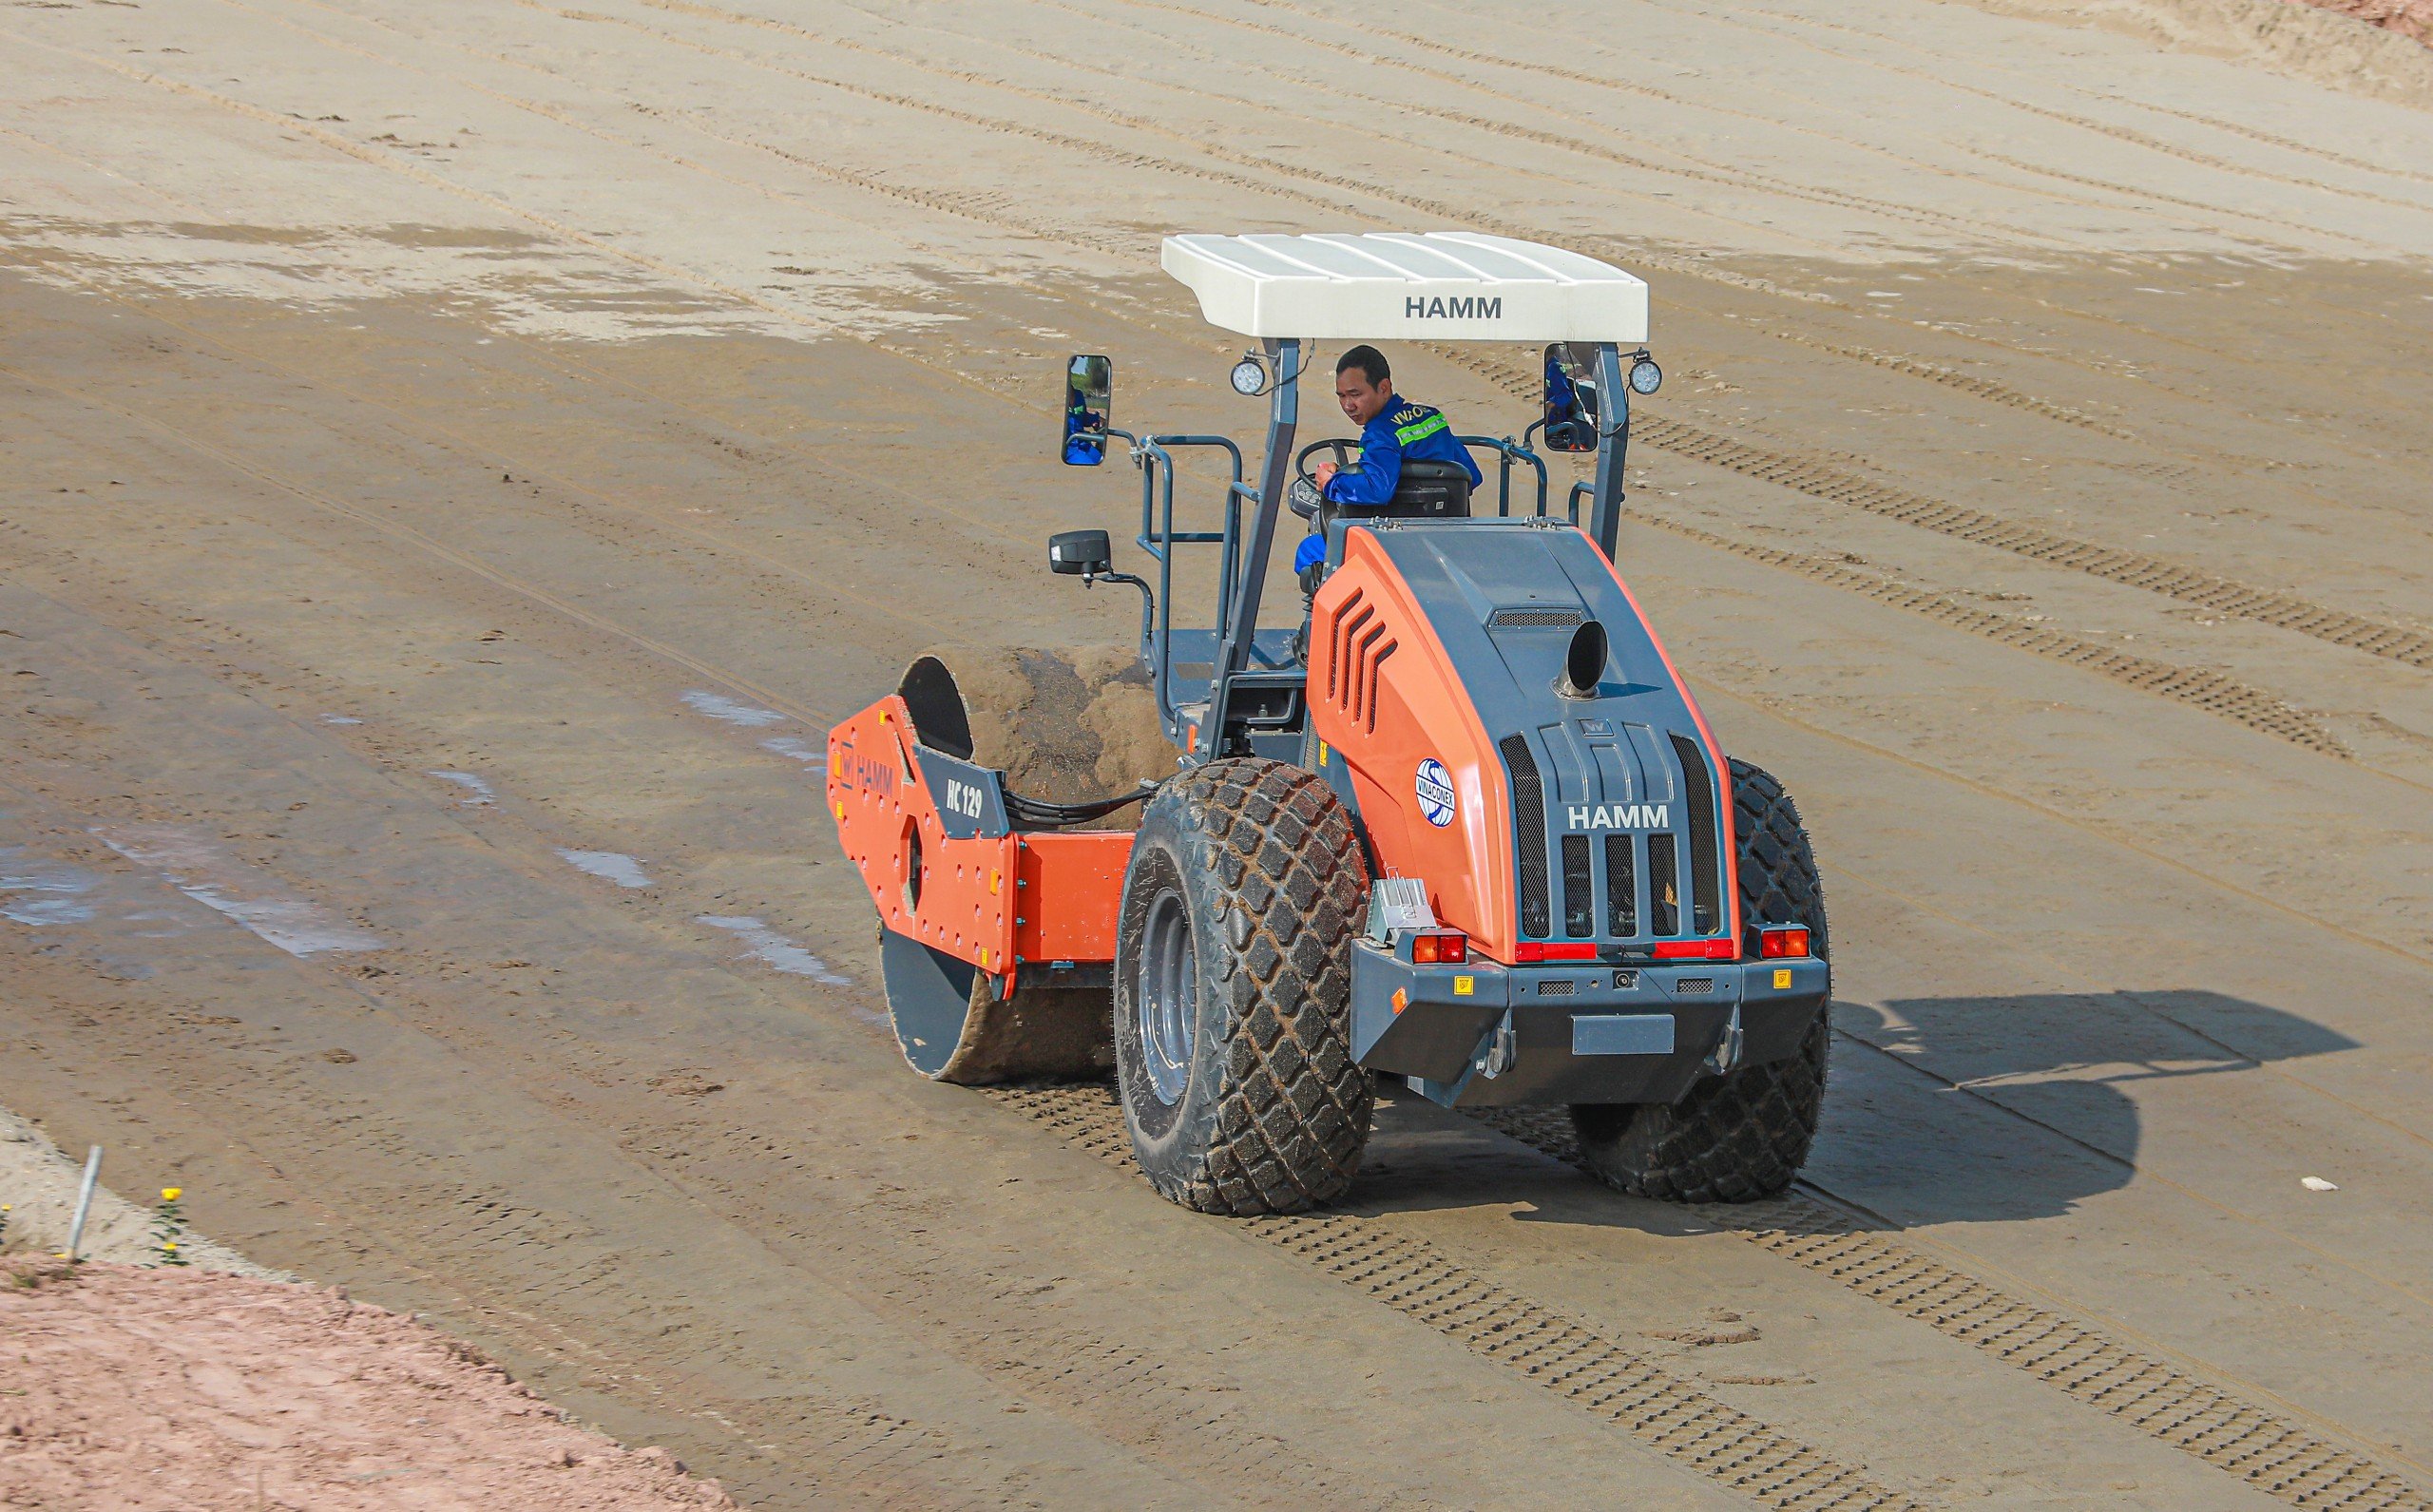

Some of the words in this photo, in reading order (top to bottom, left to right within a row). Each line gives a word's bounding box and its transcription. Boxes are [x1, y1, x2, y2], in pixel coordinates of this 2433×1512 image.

[1406, 297, 1502, 318] HAMM
[856, 755, 893, 798] HAMM
[946, 778, 962, 813] HC
[962, 785, 984, 819] 129
[1417, 777, 1454, 807] VINACONEX
[1568, 804, 1669, 830] HAMM
